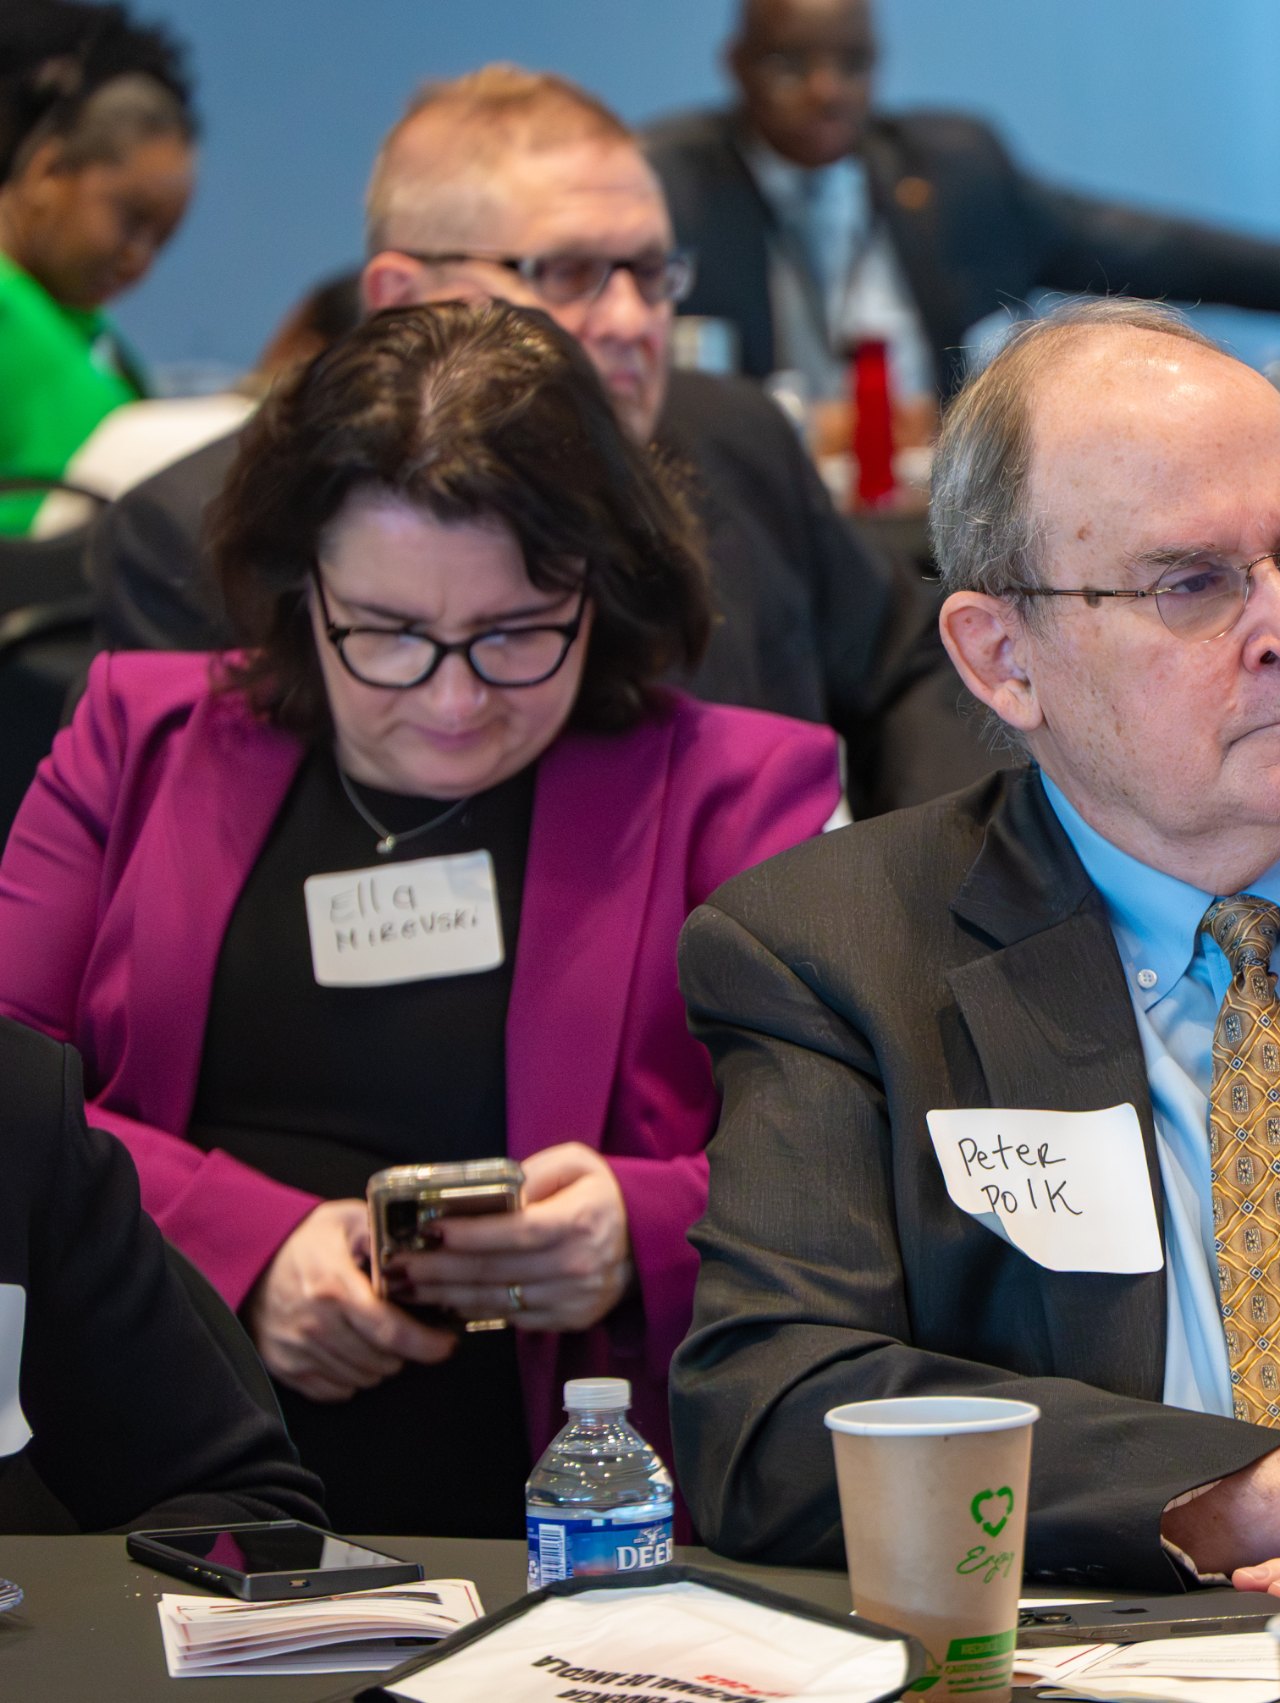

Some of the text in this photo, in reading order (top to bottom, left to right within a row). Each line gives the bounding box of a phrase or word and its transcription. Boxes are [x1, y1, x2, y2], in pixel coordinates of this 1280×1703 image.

[330, 877, 416, 924] Ella
[531, 1655, 628, 1685] ANGOLA
[614, 1673, 659, 1687] DE
